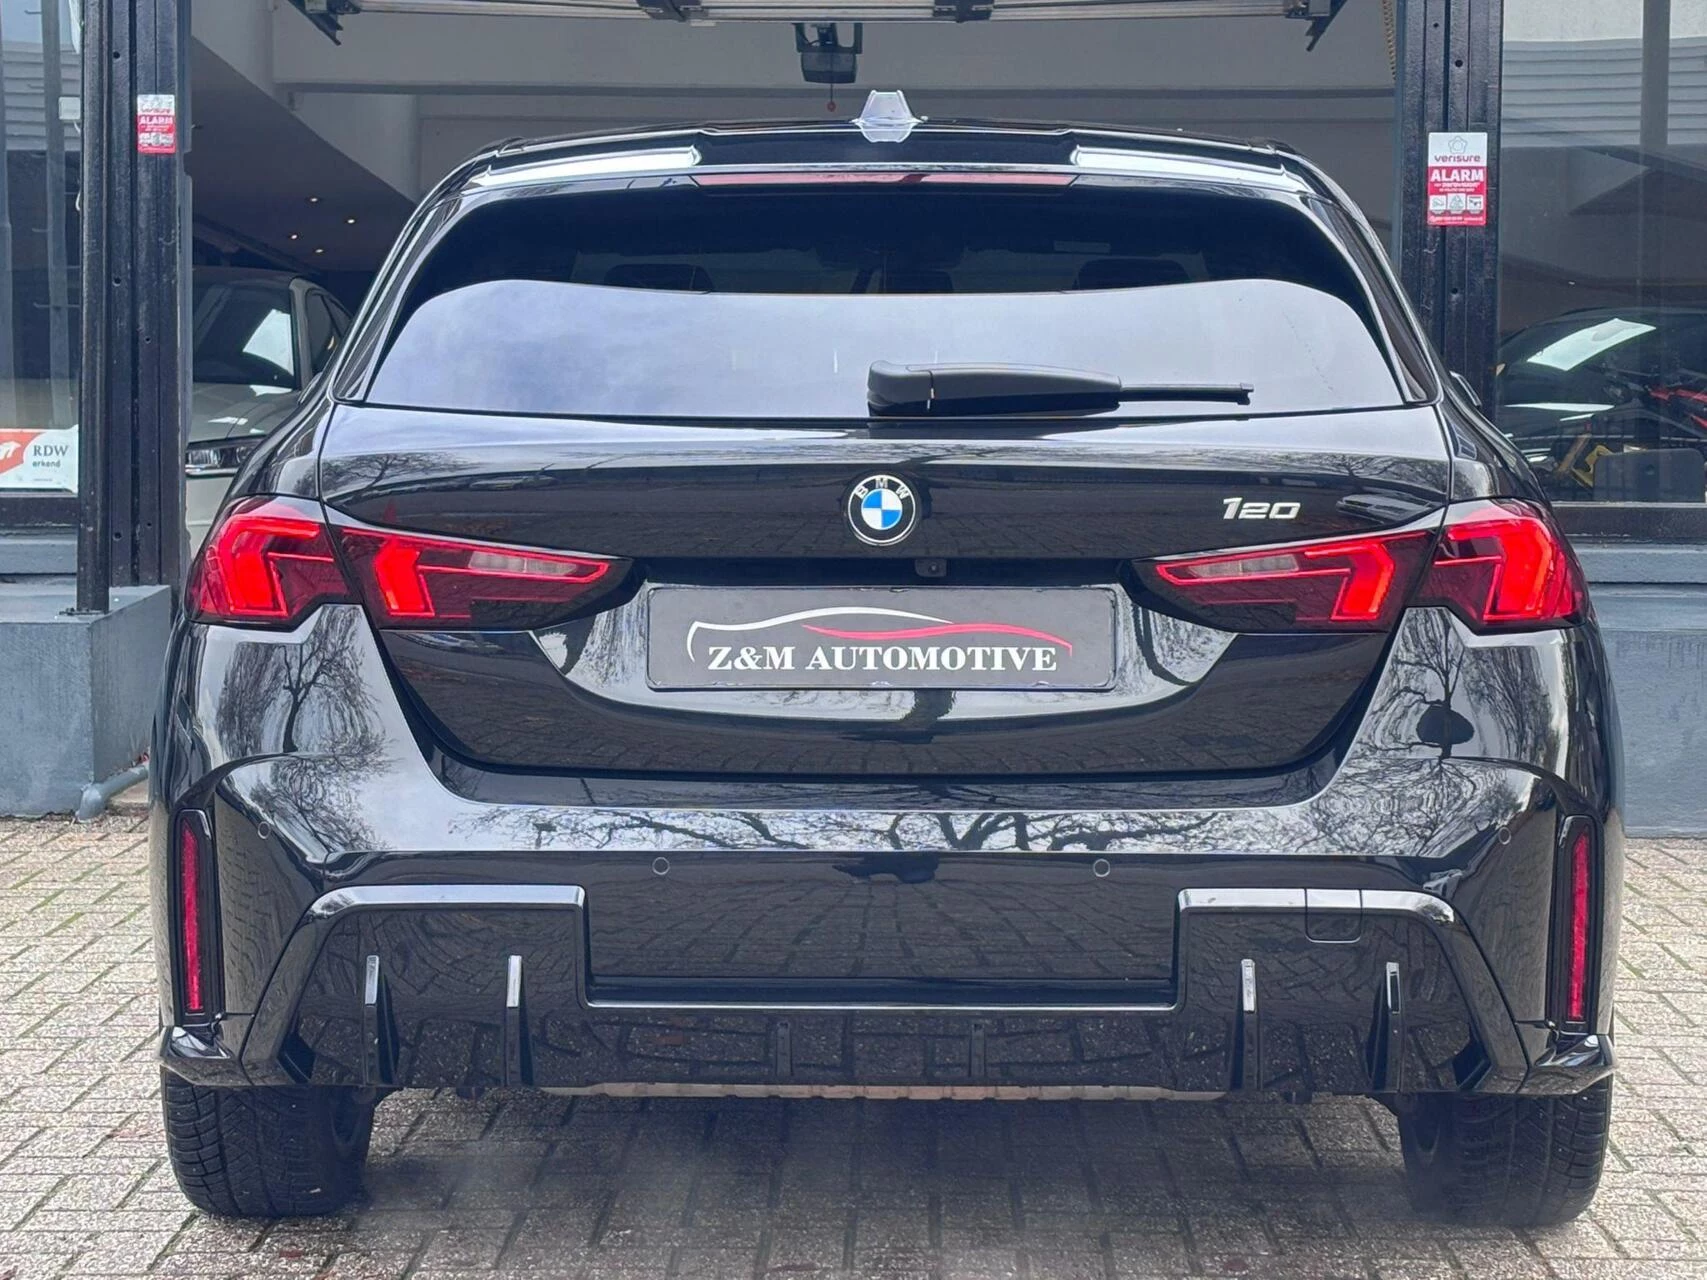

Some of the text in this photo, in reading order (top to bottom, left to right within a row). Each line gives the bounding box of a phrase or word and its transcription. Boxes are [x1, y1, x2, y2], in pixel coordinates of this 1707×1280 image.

[1434, 154, 1481, 163] verisure
[1431, 168, 1485, 183] ALARM
[33, 444, 69, 457] RDW
[32, 460, 61, 468] erkend
[855, 476, 911, 500] BMW
[1223, 497, 1301, 520] 120
[707, 646, 1058, 672] Z&M AUTOMOTIVE
